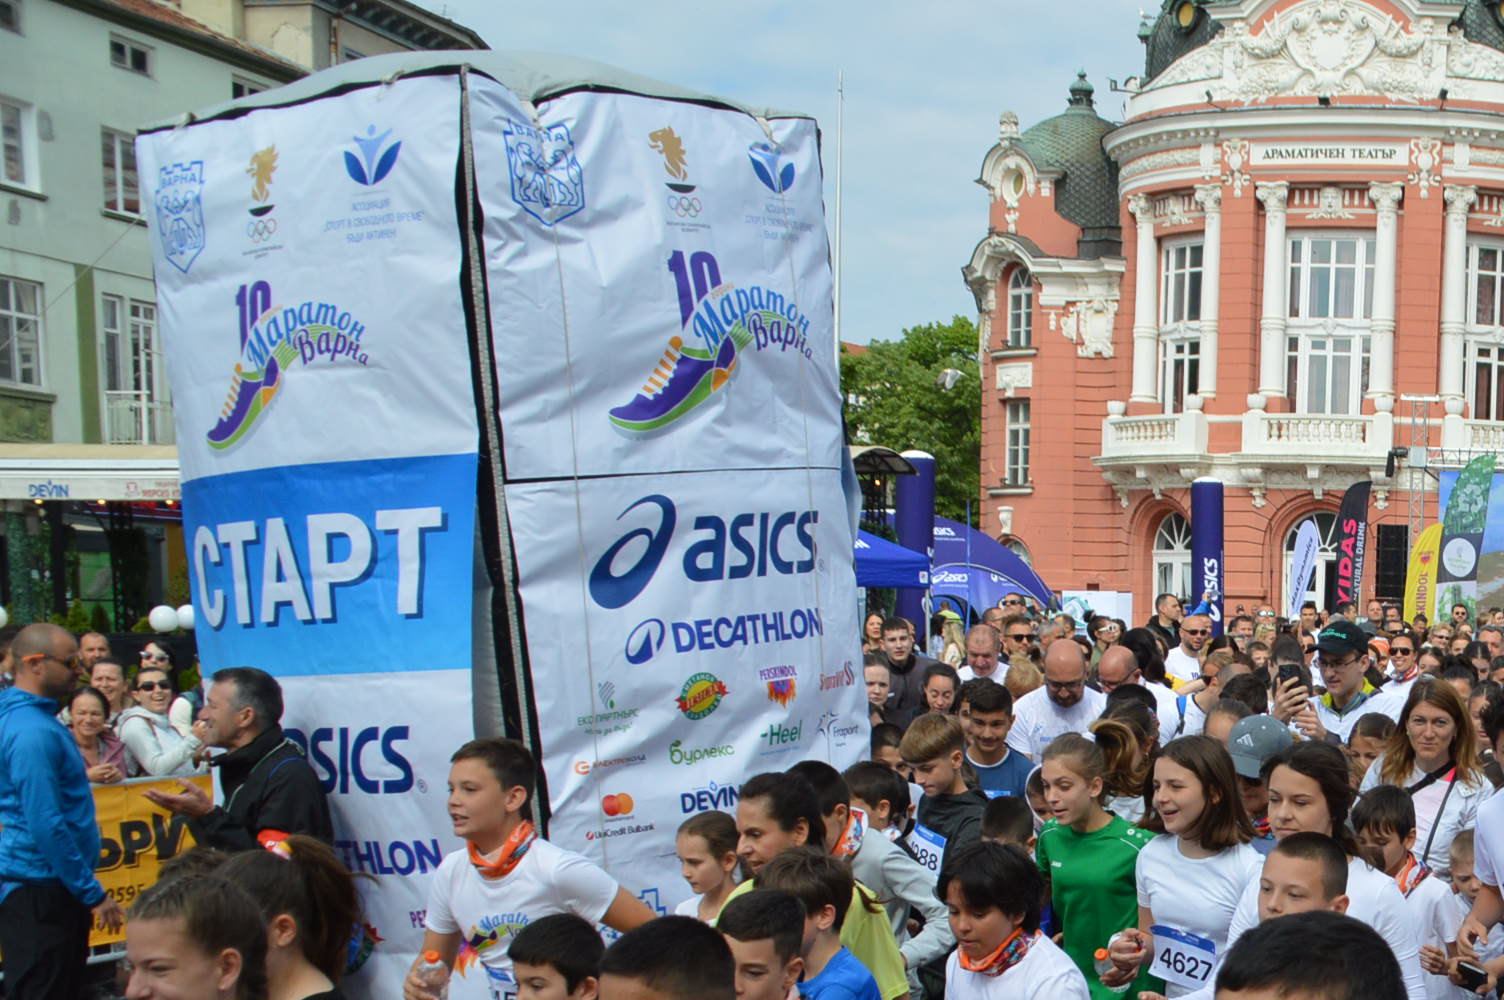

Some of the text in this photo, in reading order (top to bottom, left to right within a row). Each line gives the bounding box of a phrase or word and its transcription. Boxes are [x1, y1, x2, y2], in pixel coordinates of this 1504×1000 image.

[1262, 148, 1397, 160] ДРАМАТИЧЕН ТЕАТЪР
[668, 250, 723, 331] 10
[235, 280, 271, 357] 10
[246, 301, 366, 372] Маратон
[693, 286, 810, 355] Маратон
[748, 312, 813, 359] Варна
[293, 328, 369, 365] Варна
[28, 481, 69, 498] DEVIN
[683, 510, 818, 582] asics
[1356, 521, 1366, 555] DRINK
[194, 507, 446, 629] СТАРТ
[672, 608, 823, 653] DECATHLON
[833, 725, 859, 739] Fraport
[287, 725, 414, 794] sics
[1160, 947, 1212, 981] 4627
